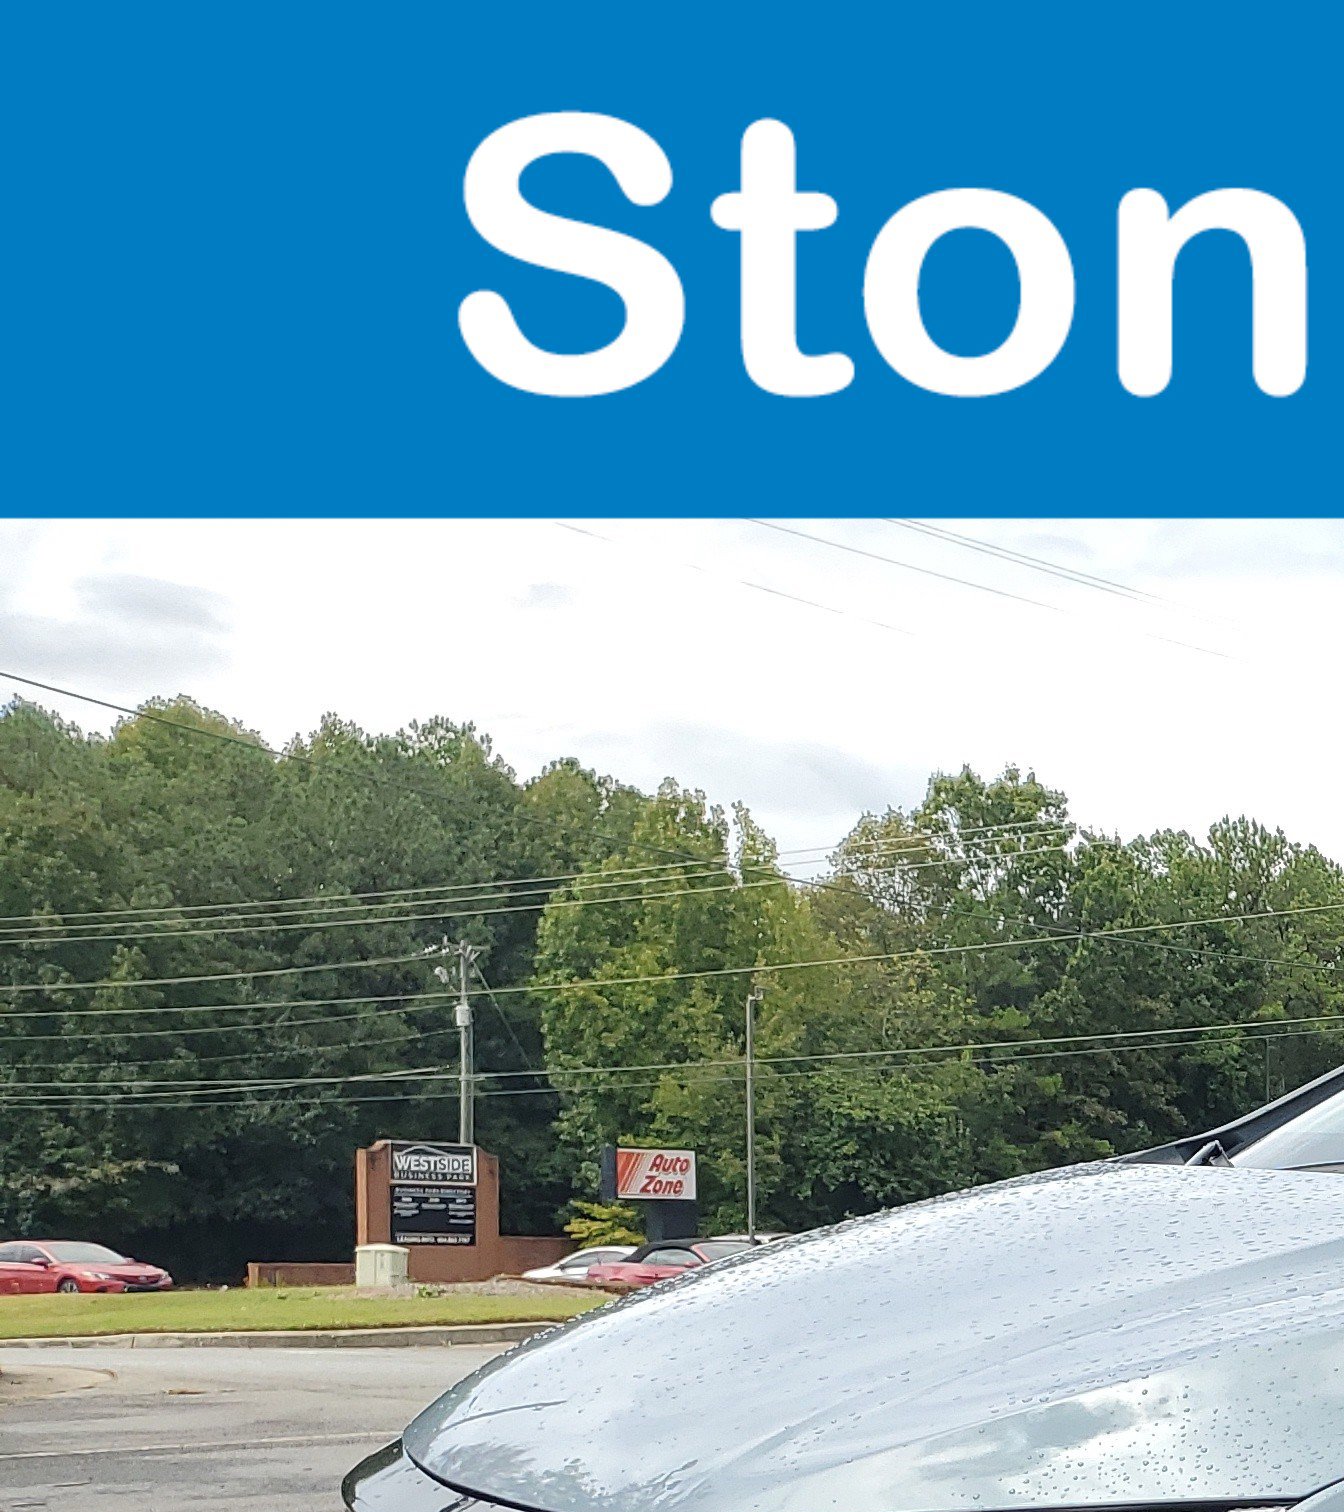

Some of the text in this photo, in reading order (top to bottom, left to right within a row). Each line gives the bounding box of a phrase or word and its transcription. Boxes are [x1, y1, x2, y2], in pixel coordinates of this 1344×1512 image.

[395, 1154, 471, 1173] WESTSIDE
[648, 1153, 690, 1174] Auto
[640, 1175, 684, 1196] Zone
